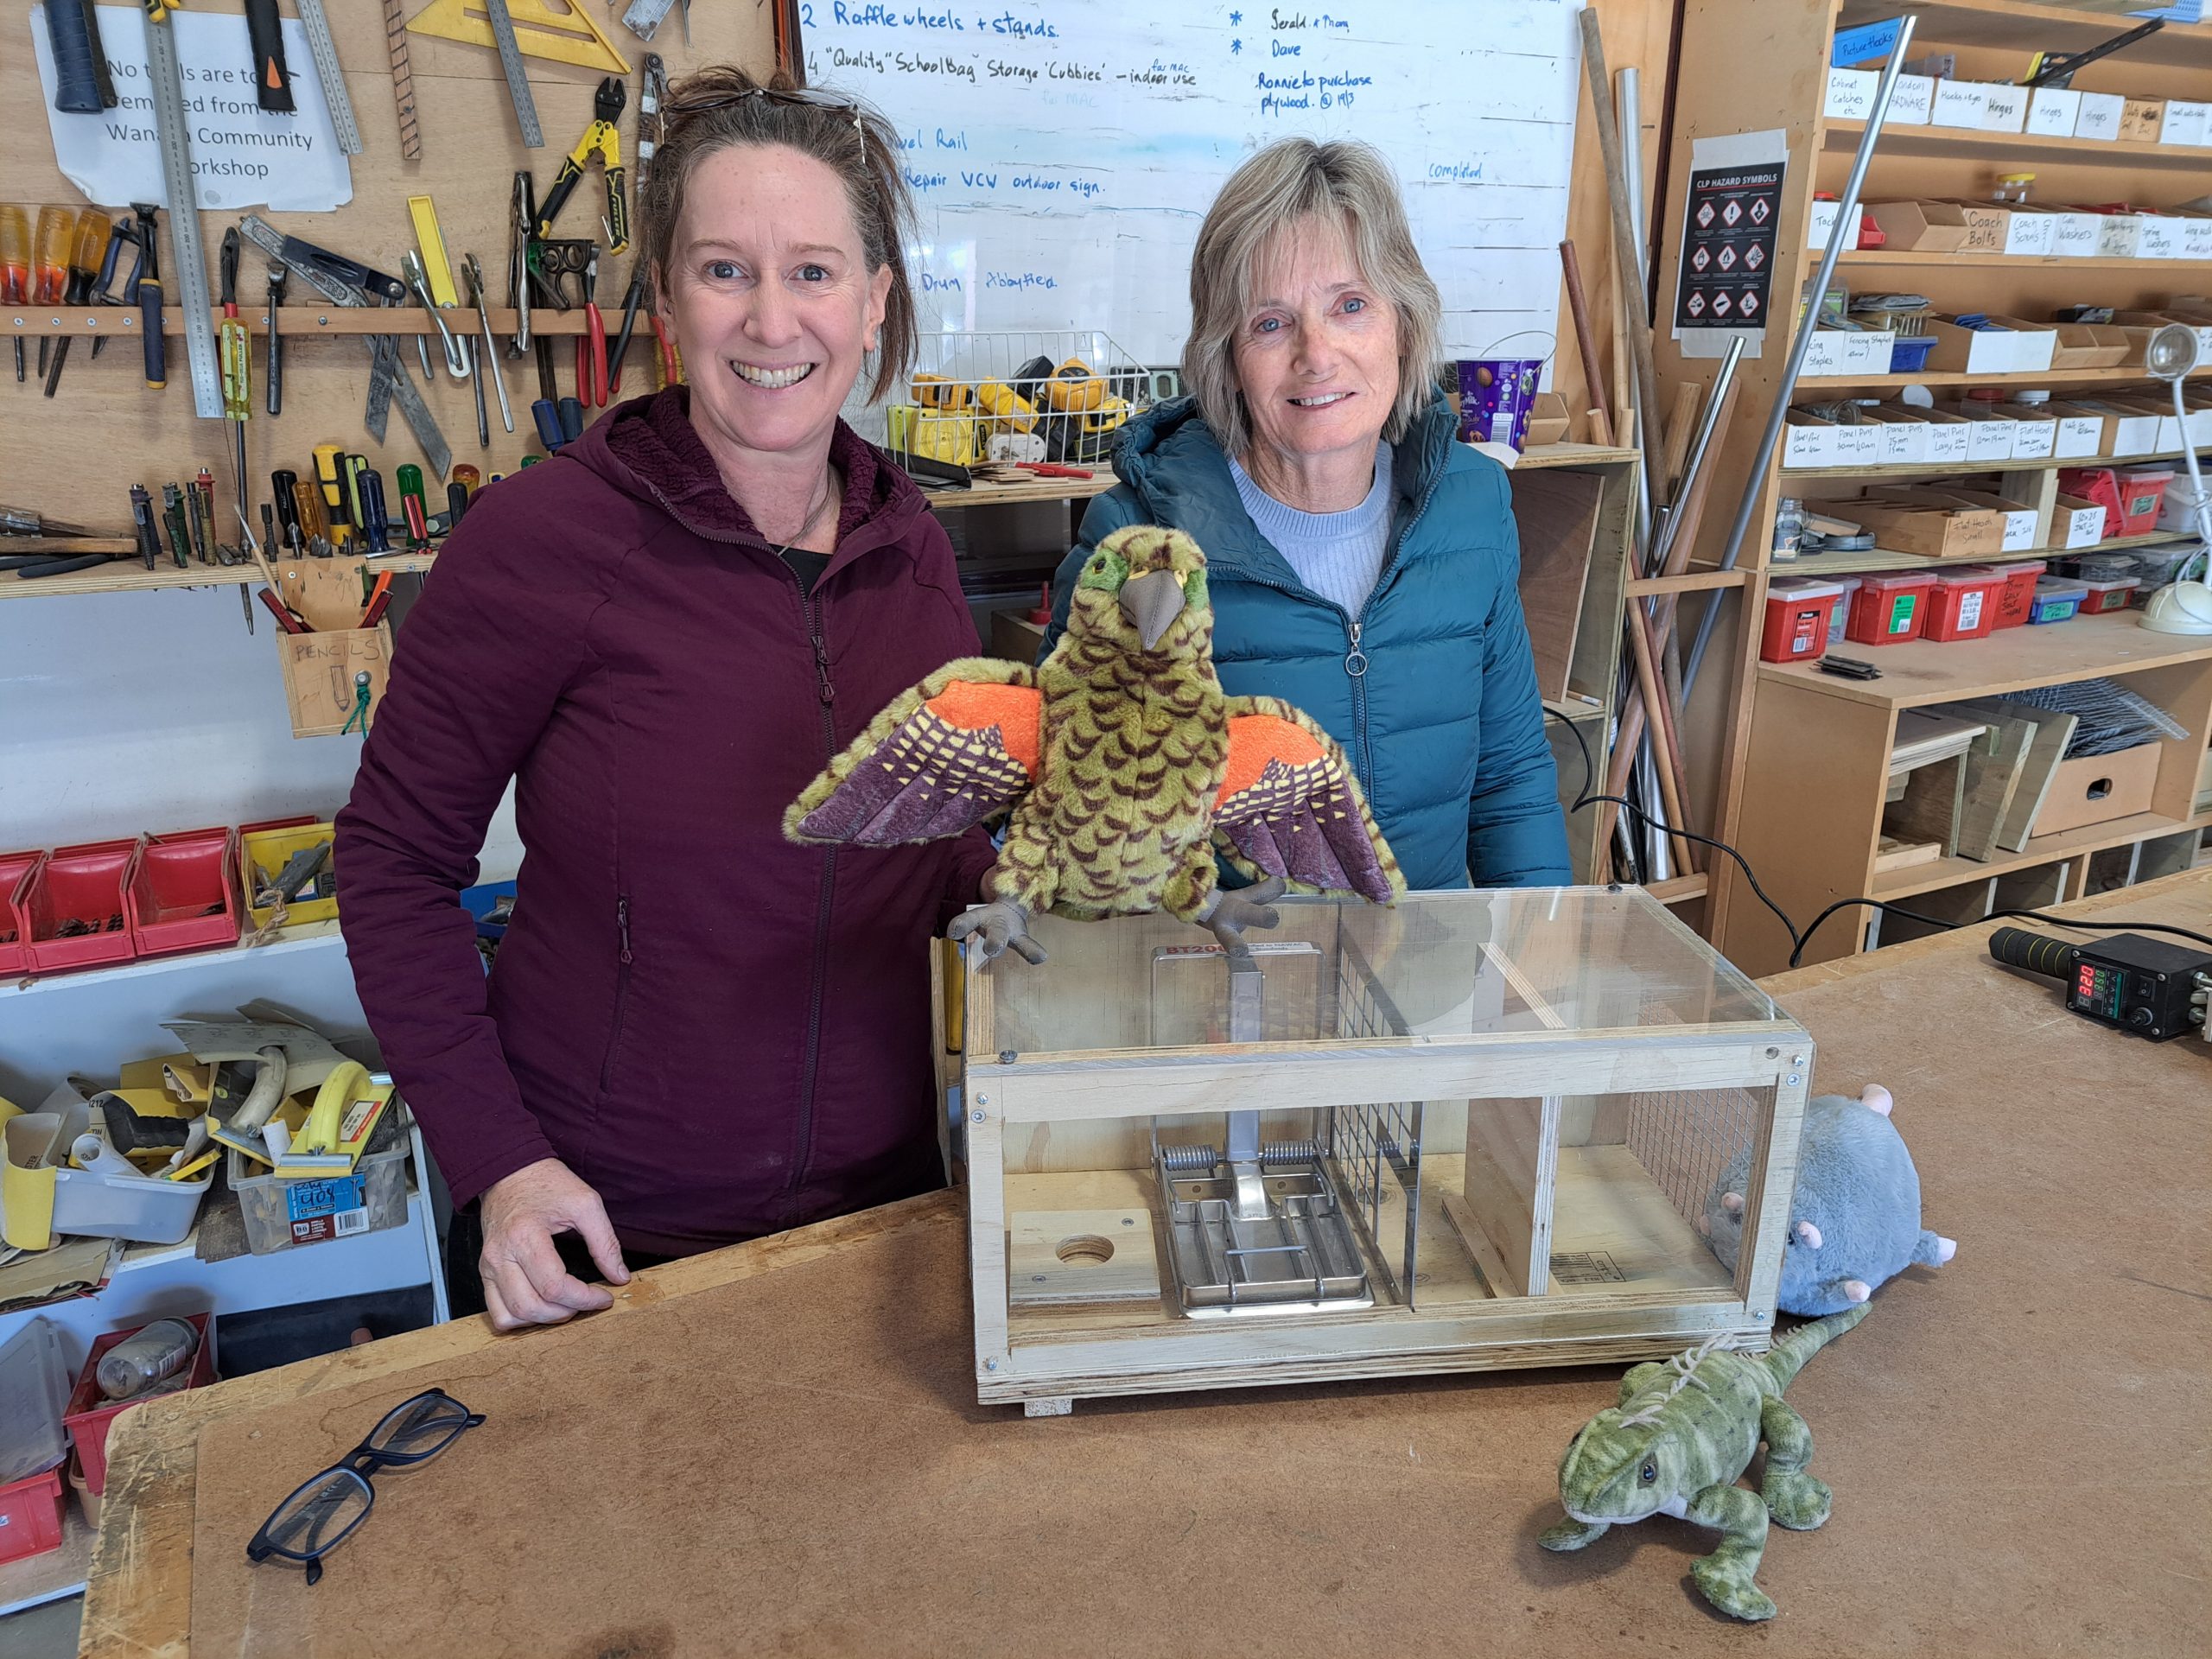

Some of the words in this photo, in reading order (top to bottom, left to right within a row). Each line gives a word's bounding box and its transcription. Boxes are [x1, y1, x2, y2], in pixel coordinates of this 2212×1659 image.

[801, 3, 817, 29] 2
[834, 1, 898, 25] Raffle
[903, 7, 964, 31] wheels
[977, 18, 988, 30] +
[1272, 39, 1301, 58] Dave
[108, 60, 137, 78] No
[143, 63, 196, 81] tls
[202, 69, 233, 83] are
[987, 60, 1039, 84] Storage
[1173, 73, 1197, 86] use
[1319, 69, 1372, 93] purchase
[1832, 77, 1858, 90] Cabinet
[211, 97, 259, 115] from
[1833, 92, 1864, 105] Catches
[1988, 98, 2013, 119] Hinges
[198, 128, 313, 151] Community
[936, 128, 967, 150] Rail
[191, 158, 270, 180] orkshop
[905, 166, 947, 193] Repair
[961, 171, 997, 188] VCW
[1696, 180, 1710, 189] CLP
[1711, 176, 1741, 188] HAZARD
[1742, 173, 1778, 185] SYMBOLS
[611, 197, 620, 237] FULLER
[1968, 211, 2003, 228] Coach
[1968, 231, 1997, 246] Bolts
[2059, 227, 2092, 240] Washers
[921, 273, 962, 292] Drum
[296, 640, 380, 662] PENCILS
[2079, 965, 2094, 996] 320
